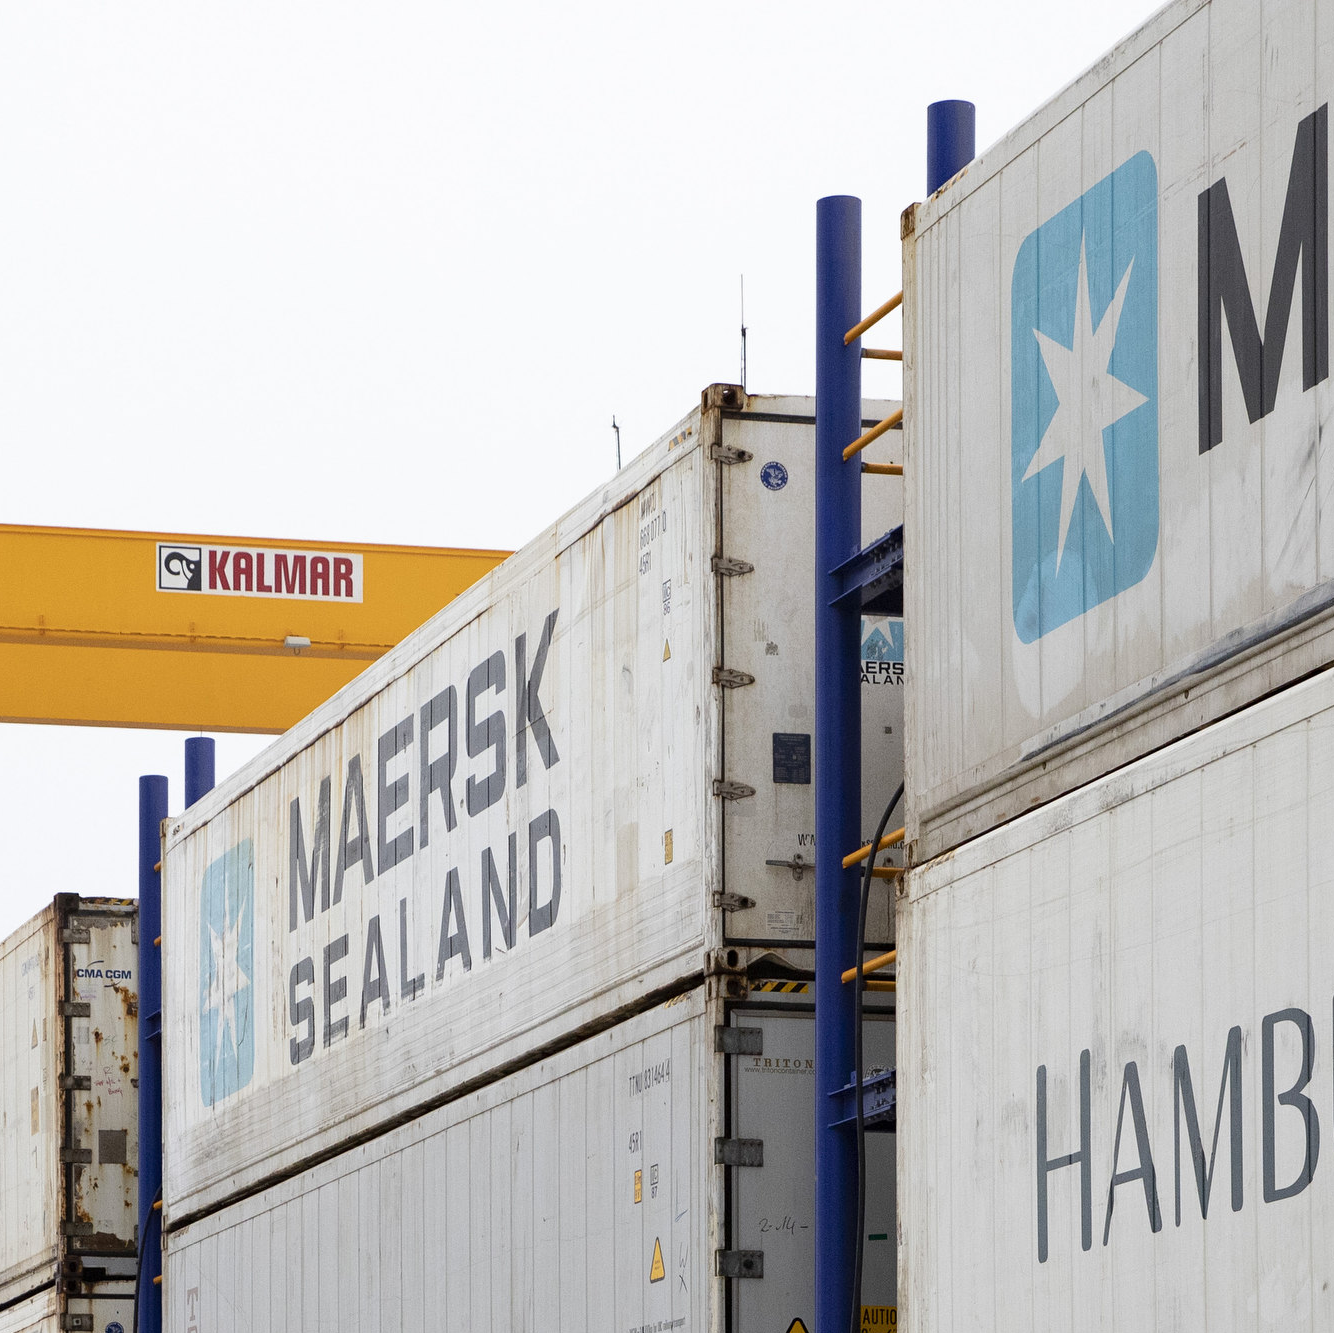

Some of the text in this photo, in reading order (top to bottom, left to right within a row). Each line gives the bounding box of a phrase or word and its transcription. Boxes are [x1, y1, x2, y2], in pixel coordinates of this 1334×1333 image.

[208, 550, 355, 599] KALMAR
[288, 606, 560, 933] MAERSK
[288, 807, 563, 1066] SEALAND
[76, 968, 132, 980] CMA CGM
[752, 1057, 814, 1069] TRITON
